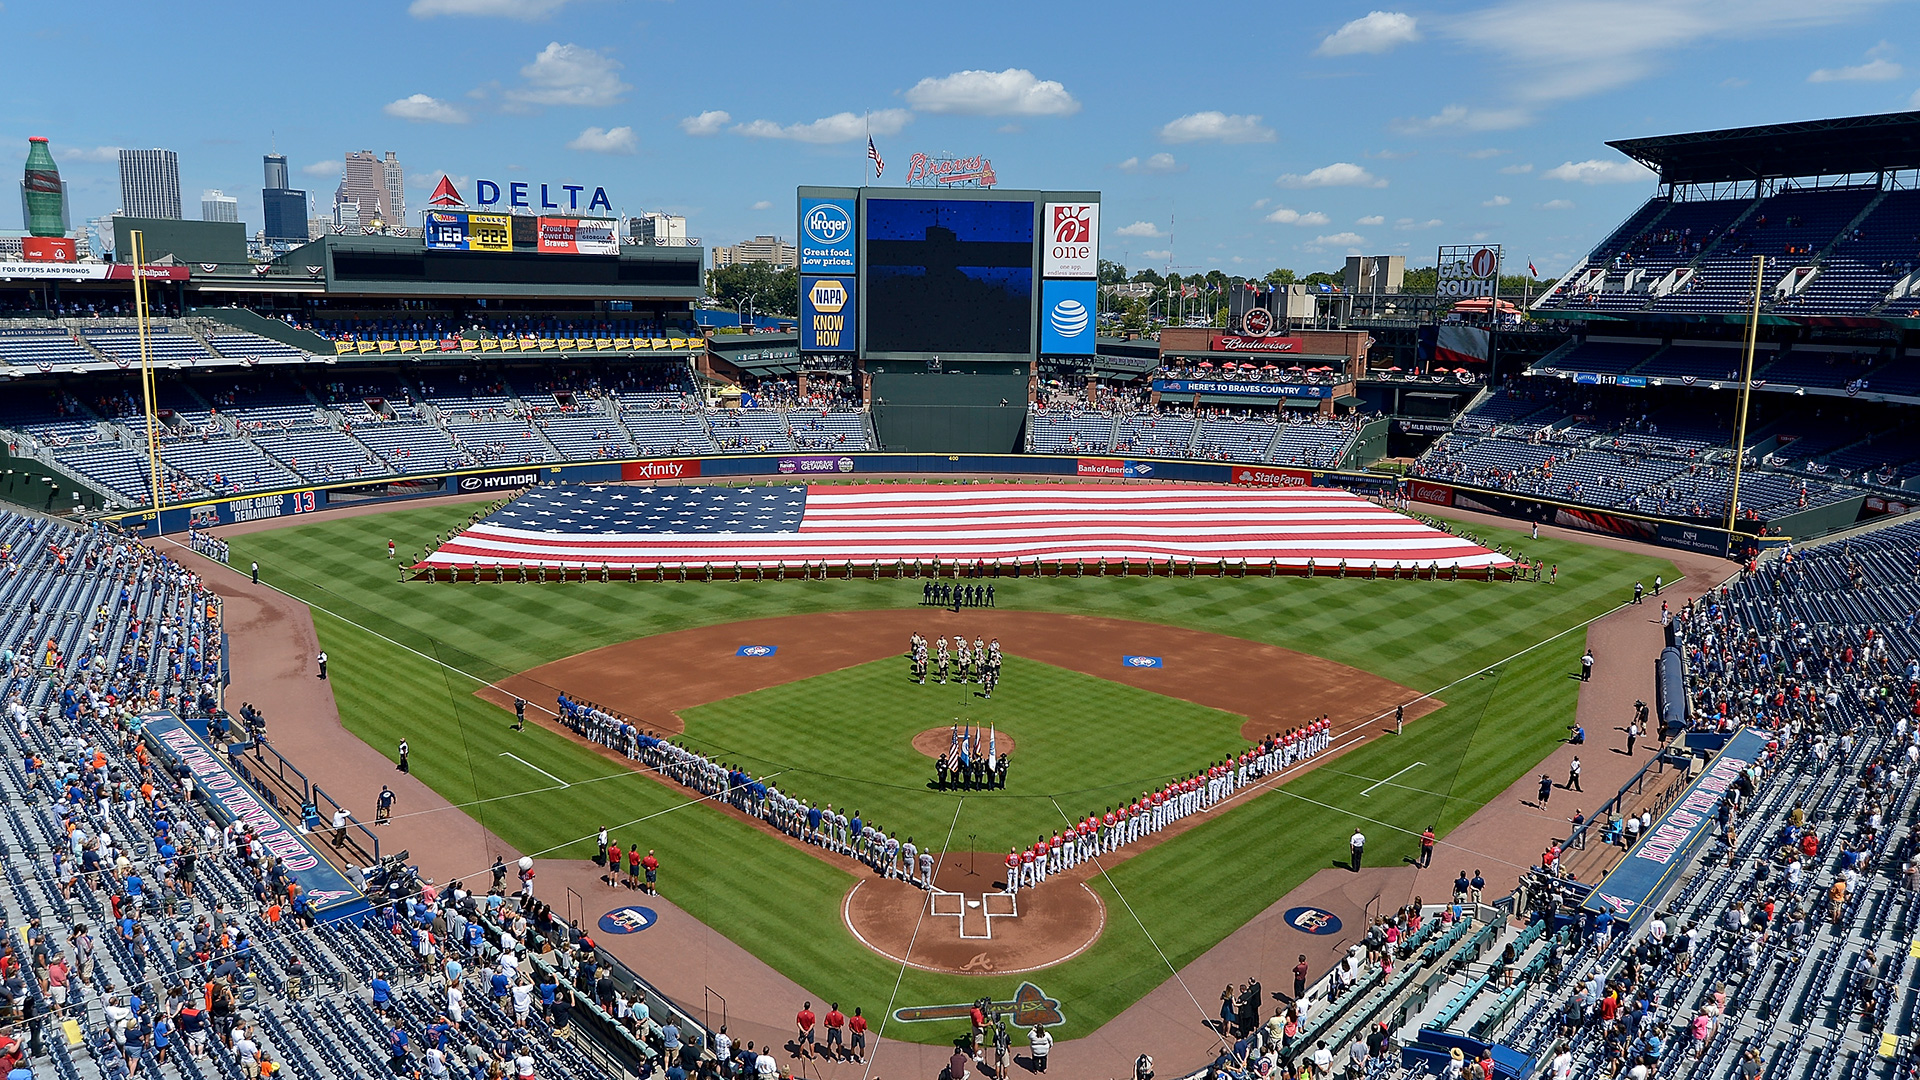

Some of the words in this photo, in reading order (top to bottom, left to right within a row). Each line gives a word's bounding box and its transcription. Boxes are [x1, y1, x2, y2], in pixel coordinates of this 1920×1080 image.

[906, 152, 982, 184] Braves
[476, 179, 612, 211] DELTA
[541, 224, 562, 232] Proud
[810, 211, 846, 239] Kroger
[539, 231, 561, 239] Power
[562, 232, 574, 240] the
[803, 248, 829, 257] Great
[830, 248, 853, 257] food.
[1052, 246, 1090, 259] one
[803, 256, 822, 266] Low
[822, 257, 854, 267] prices.
[1438, 262, 1472, 278] GAS
[1437, 280, 1494, 296] SOUTH
[815, 288, 842, 305] NAPA
[813, 314, 845, 331] KNOW
[816, 330, 840, 347] HOW
[1221, 337, 1293, 351] Budweiser
[1601, 375, 1617, 385] 1:17
[1188, 383, 1216, 391] HERE'S
[1228, 385, 1259, 393] BRAVES
[1260, 386, 1300, 395] COUNTRY
[638, 462, 681, 478] xfinity
[801, 463, 834, 471] GETAWAYS
[1097, 465, 1104, 473] of
[1104, 466, 1134, 474] America
[483, 473, 538, 488] HYUNDAI
[1254, 471, 1279, 484] State
[1279, 473, 1305, 485] Farm
[229, 499, 254, 512] HOME
[254, 494, 284, 508] GAMES
[293, 491, 317, 514] 13
[142, 512, 156, 520] 335
[234, 505, 281, 522] REMAINING
[1660, 535, 1692, 546] NORTHSIDE
[1692, 541, 1719, 551] HOSPITAL
[1730, 534, 1744, 543] 330
[158, 727, 223, 777] WELCOME
[202, 771, 238, 791] TO
[1696, 756, 1748, 794] BRAVES
[1679, 789, 1720, 814] THE
[216, 786, 281, 838] TURNER
[1666, 809, 1703, 829] OF
[259, 829, 319, 872] FIELD
[1635, 823, 1692, 865] HOME
